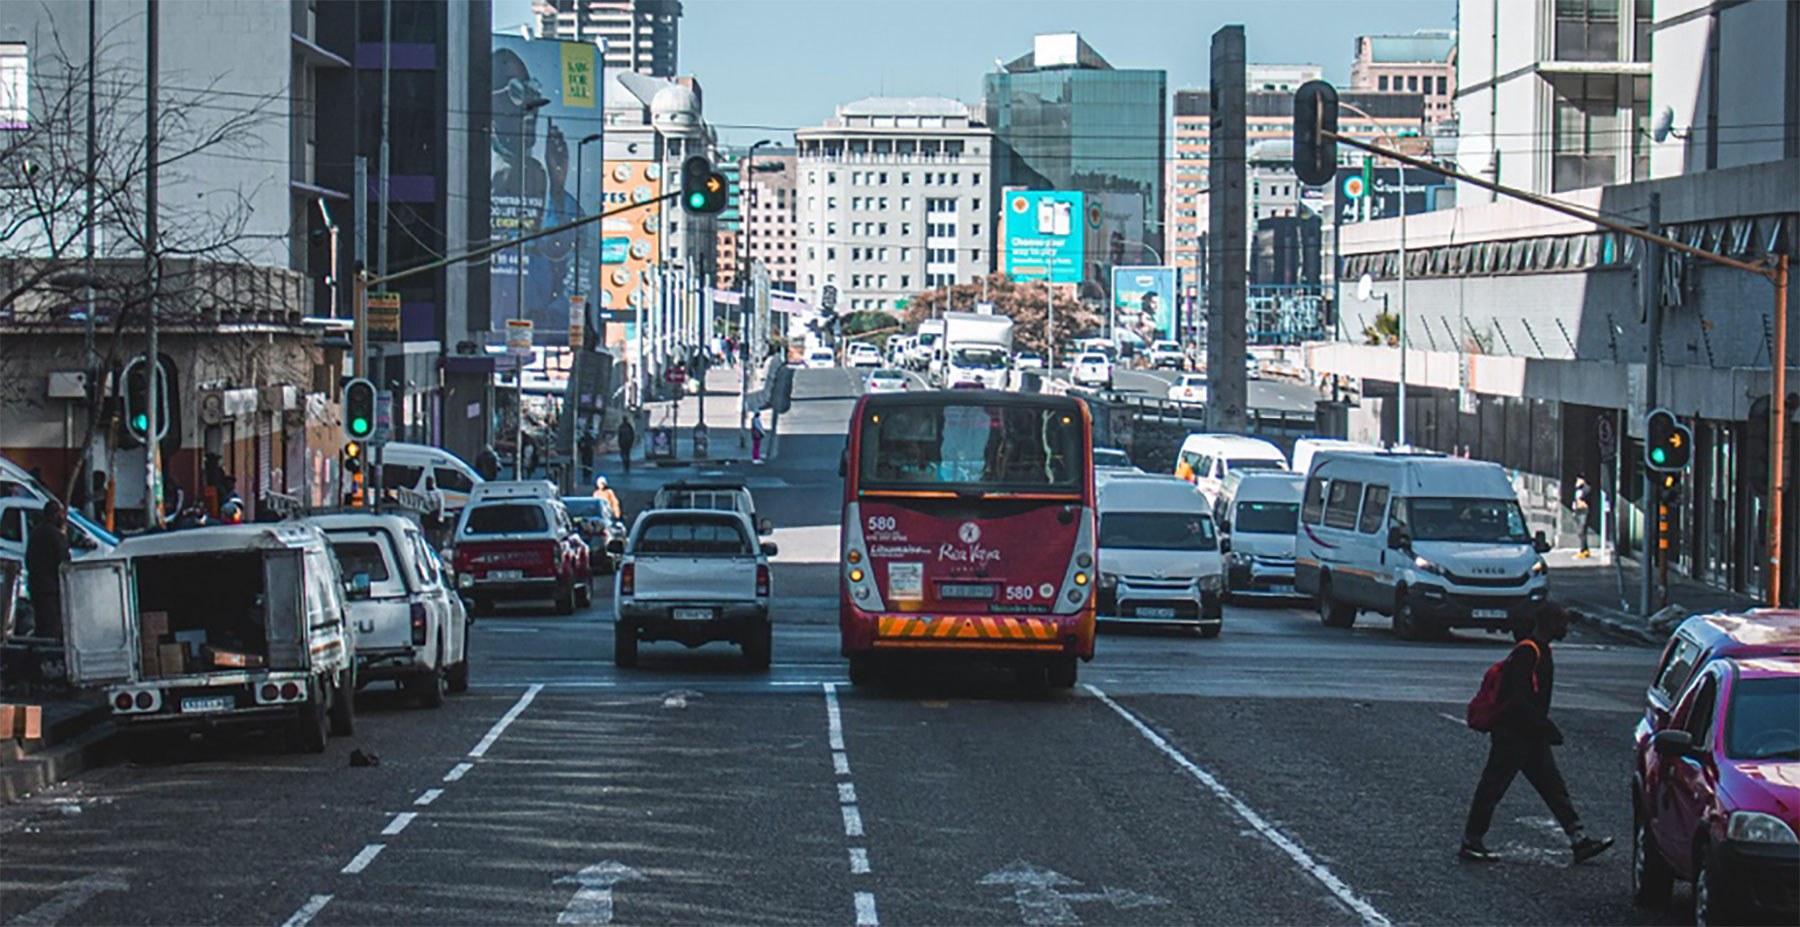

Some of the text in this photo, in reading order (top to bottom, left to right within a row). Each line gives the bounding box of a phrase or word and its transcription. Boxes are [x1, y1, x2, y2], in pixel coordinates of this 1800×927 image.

[868, 516, 896, 531] 580
[938, 542, 968, 562] Rea
[1472, 567, 1505, 575] IVECO
[1006, 585, 1033, 600] 580
